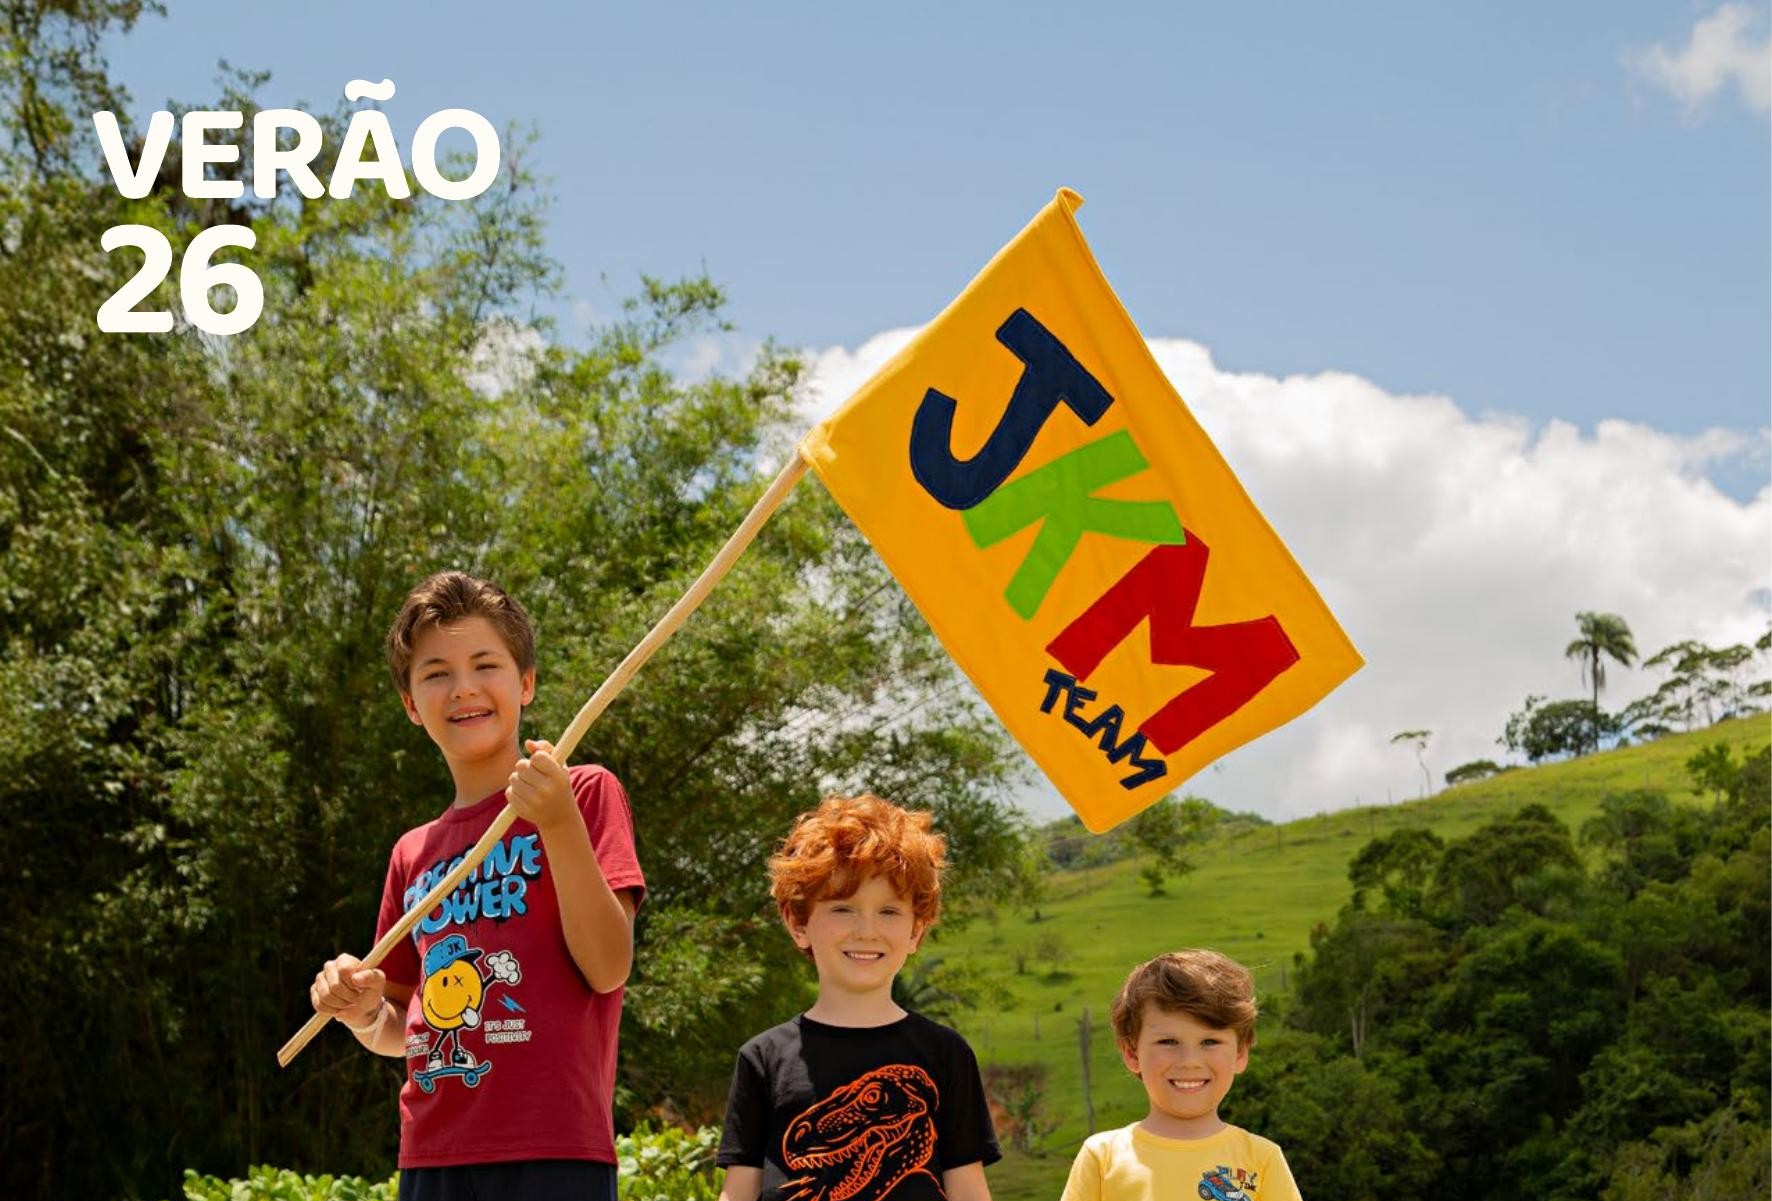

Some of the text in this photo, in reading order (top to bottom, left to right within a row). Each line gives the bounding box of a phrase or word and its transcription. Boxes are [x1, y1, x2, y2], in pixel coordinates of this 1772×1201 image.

[909, 307, 1300, 756] JKM
[1040, 669, 1167, 790] TEAM
[447, 941, 462, 956] JK
[502, 1018, 525, 1030] JUST
